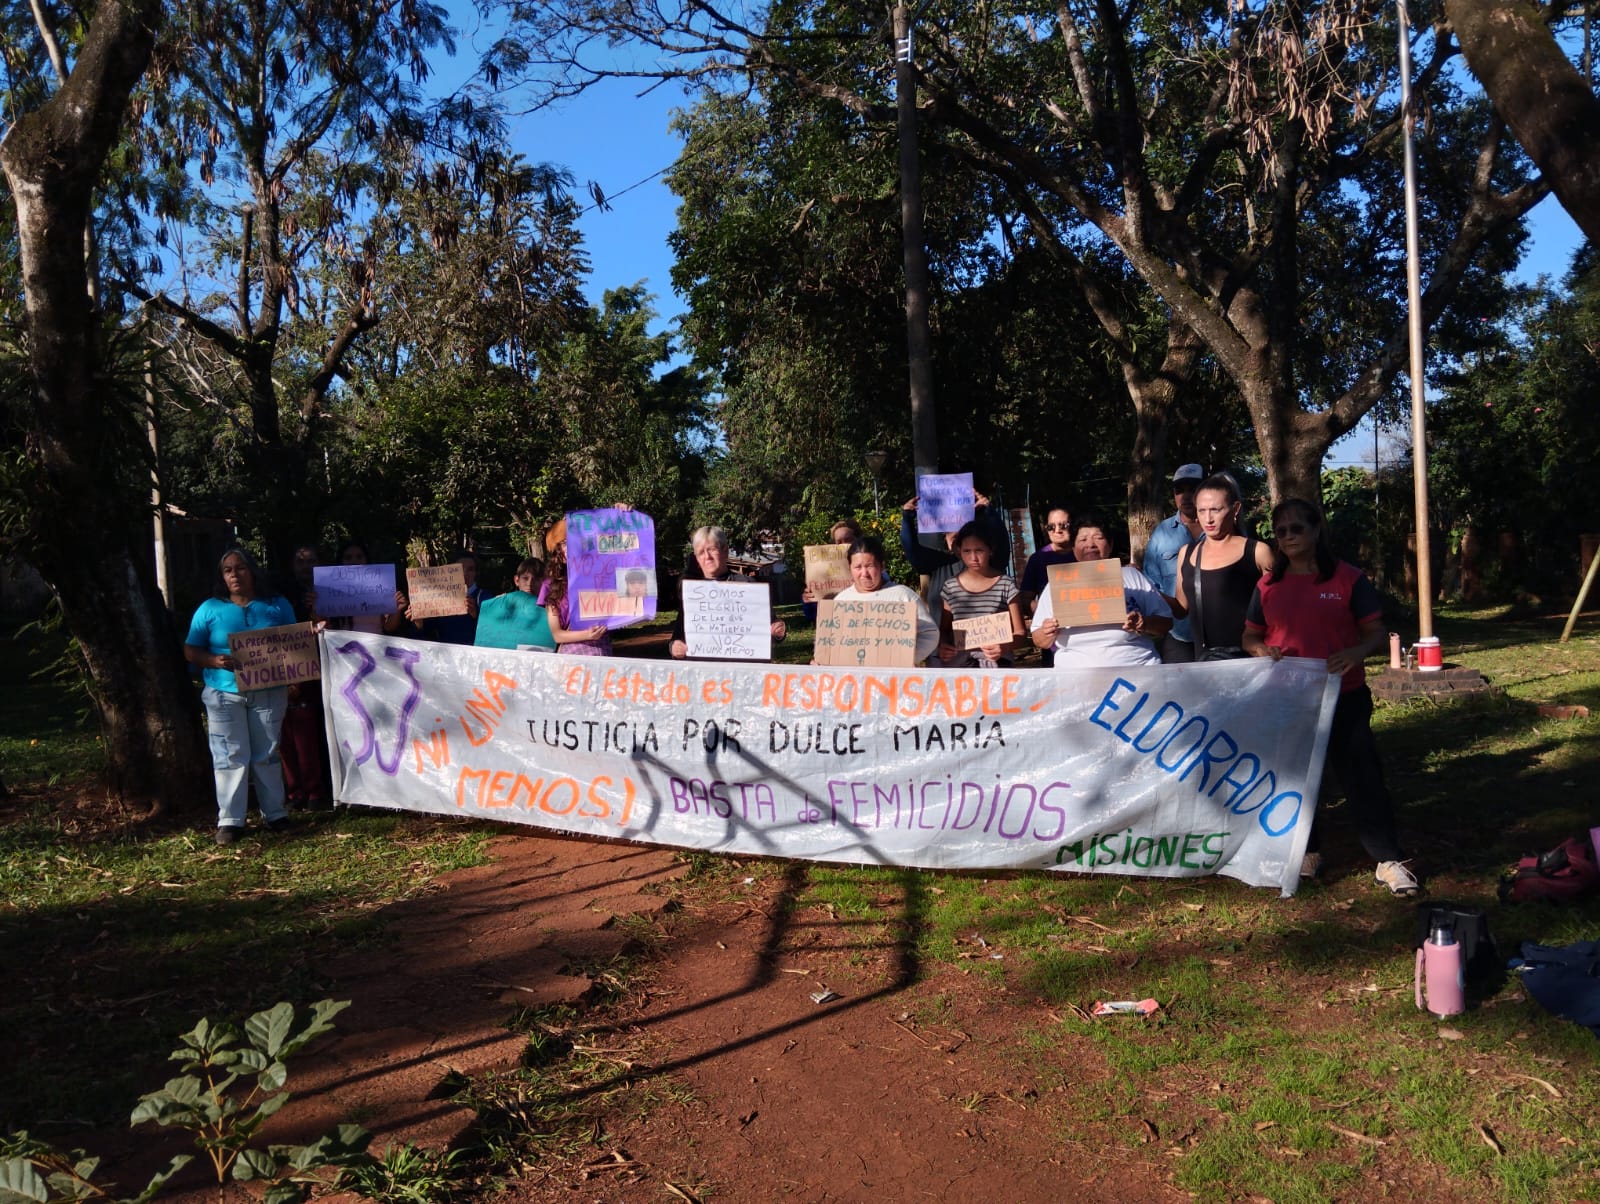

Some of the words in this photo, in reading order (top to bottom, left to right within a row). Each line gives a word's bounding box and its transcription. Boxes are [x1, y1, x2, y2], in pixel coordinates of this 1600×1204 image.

[688, 586, 745, 600] SOMOS
[834, 601, 864, 613] MÁS
[870, 602, 906, 615] VOCES
[691, 613, 707, 622] DE
[820, 616, 841, 629] MÁS
[848, 618, 911, 631] DERECHOS
[231, 639, 245, 652] LA
[712, 634, 745, 649] VOZ
[839, 635, 870, 647] LIBRES
[249, 650, 262, 658] DE
[267, 646, 278, 654] LA
[282, 641, 310, 653] VIDA
[240, 660, 320, 687] VIOLENCIA
[603, 668, 691, 704] Estado
[703, 679, 734, 704] es
[762, 672, 1022, 718] RESPONSABLE
[459, 669, 518, 747] UNA
[526, 718, 659, 753] JUSTICIA
[682, 718, 742, 753] POR
[769, 720, 866, 755] DULCE
[1089, 677, 1303, 837] ELDORADO
[669, 777, 777, 822] BASTA
[797, 793, 821, 825] de
